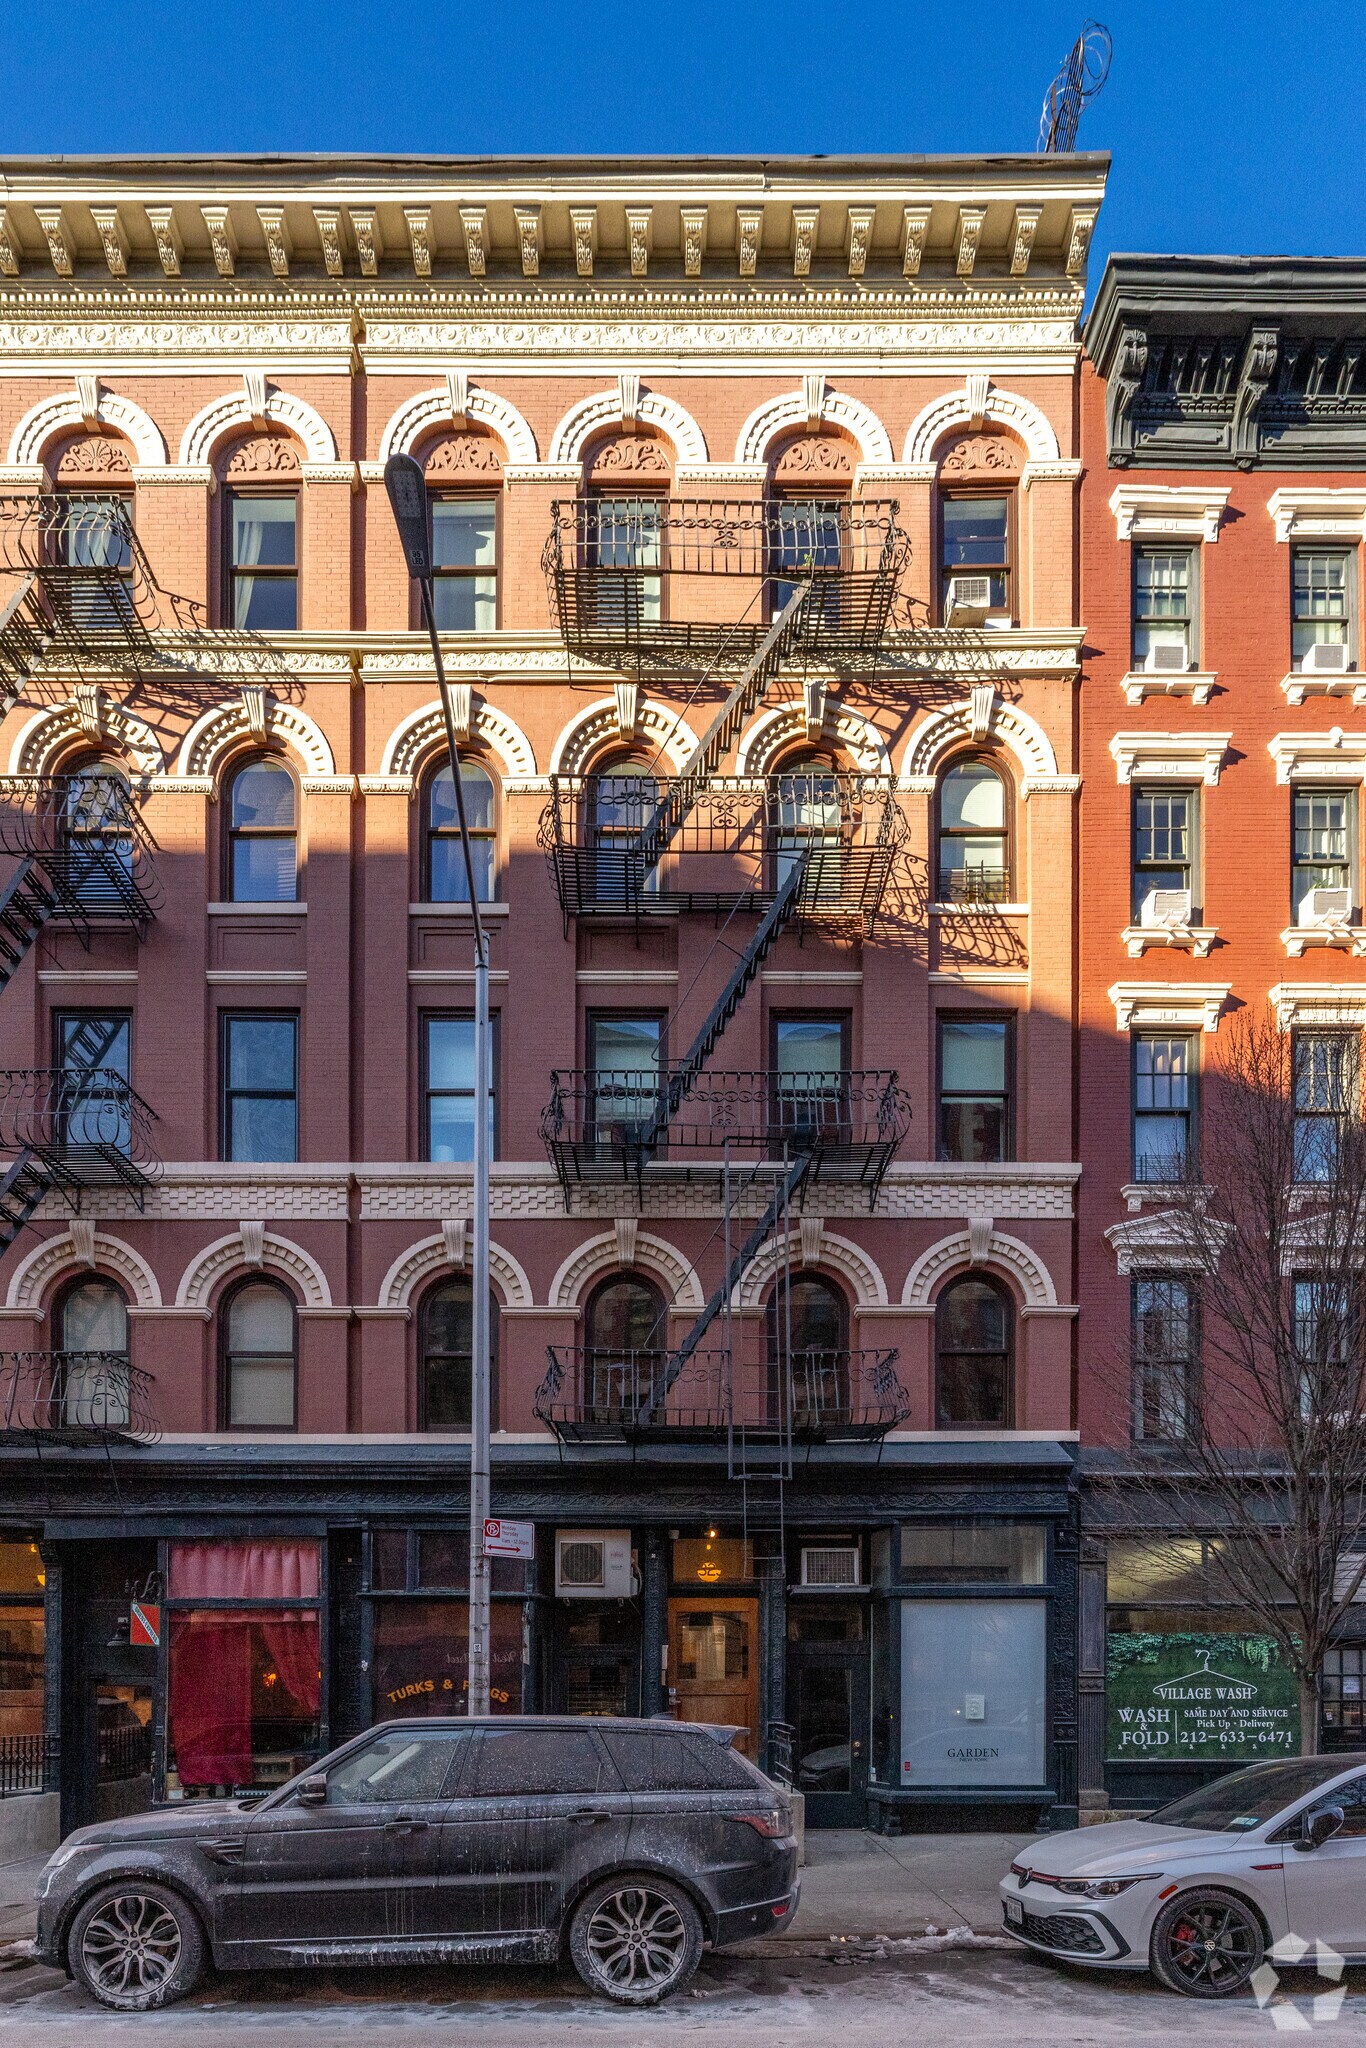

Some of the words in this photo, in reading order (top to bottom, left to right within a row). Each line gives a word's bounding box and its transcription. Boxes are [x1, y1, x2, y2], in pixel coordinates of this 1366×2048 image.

[387, 1680, 434, 1703] TURKS
[443, 1679, 453, 1690] &
[462, 1680, 510, 1703] FGS
[1159, 1688, 1212, 1699] VILLAGE
[1216, 1688, 1251, 1699] WASH
[1118, 1709, 1170, 1722] WASH
[1184, 1710, 1207, 1718] SAME
[1210, 1710, 1228, 1718] DAY
[1231, 1710, 1249, 1718] AND
[1252, 1710, 1288, 1718] SERVICE
[1140, 1722, 1148, 1730] &
[1197, 1720, 1215, 1728] Pick
[1218, 1720, 1230, 1729] Up
[1240, 1720, 1274, 1729] Delivery
[1122, 1731, 1169, 1745] FOLD
[1180, 1731, 1293, 1743] 212-633-6471
[948, 1748, 999, 1758] GARDEN
